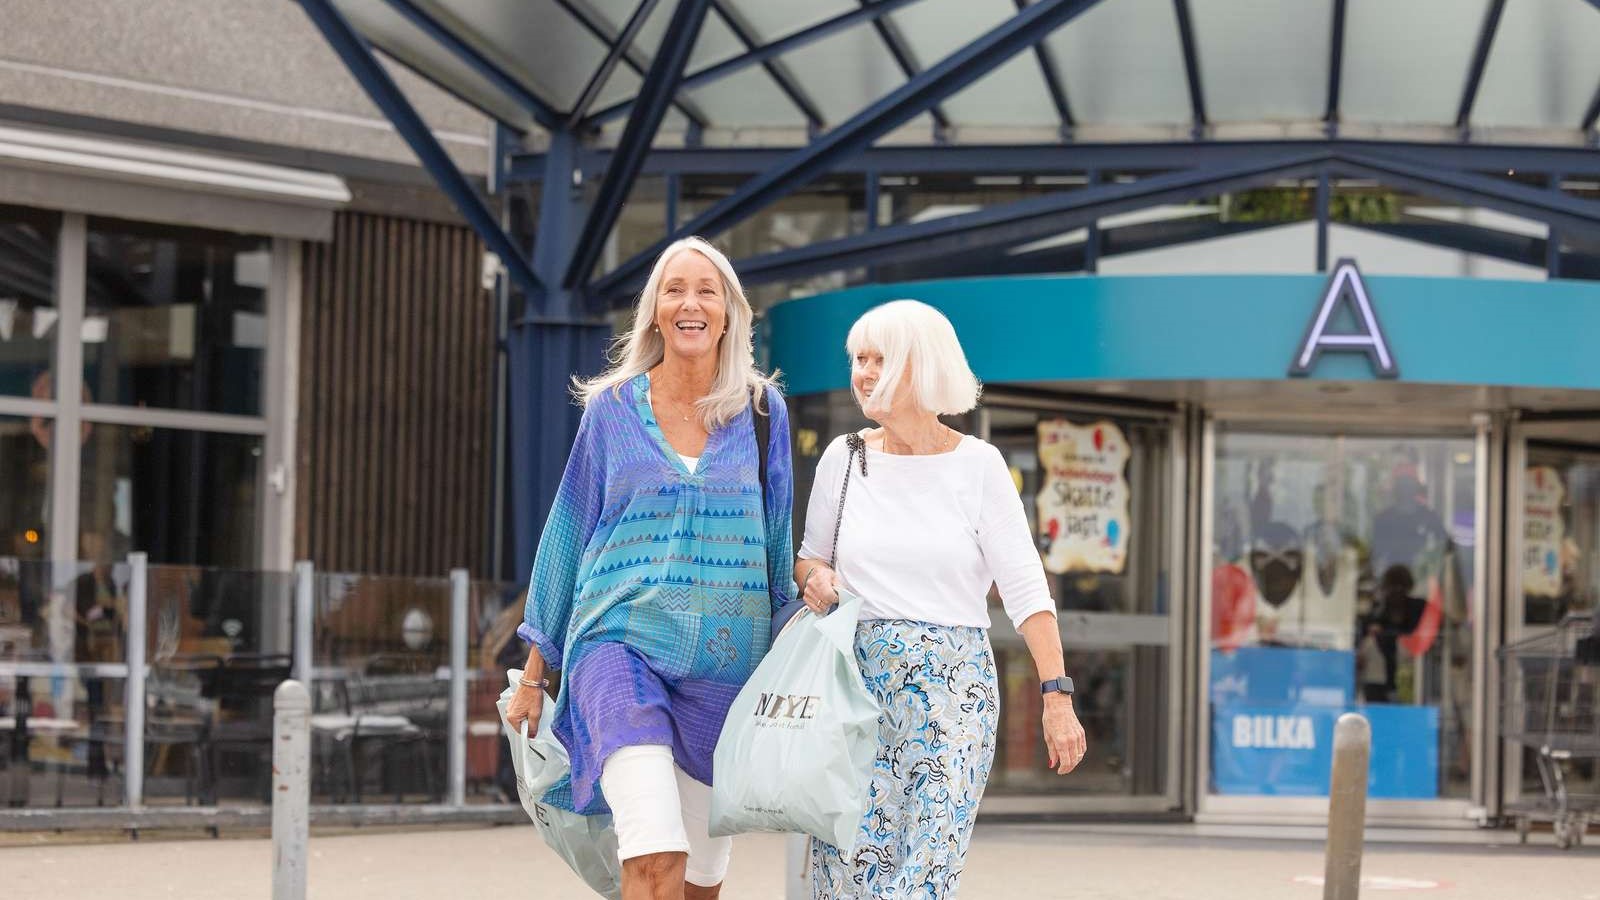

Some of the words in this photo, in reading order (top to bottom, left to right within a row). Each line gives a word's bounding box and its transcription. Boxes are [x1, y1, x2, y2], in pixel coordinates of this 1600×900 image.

[1287, 258, 1399, 378] A
[1053, 481, 1114, 509] Skatte
[1232, 715, 1316, 749] BILKA
